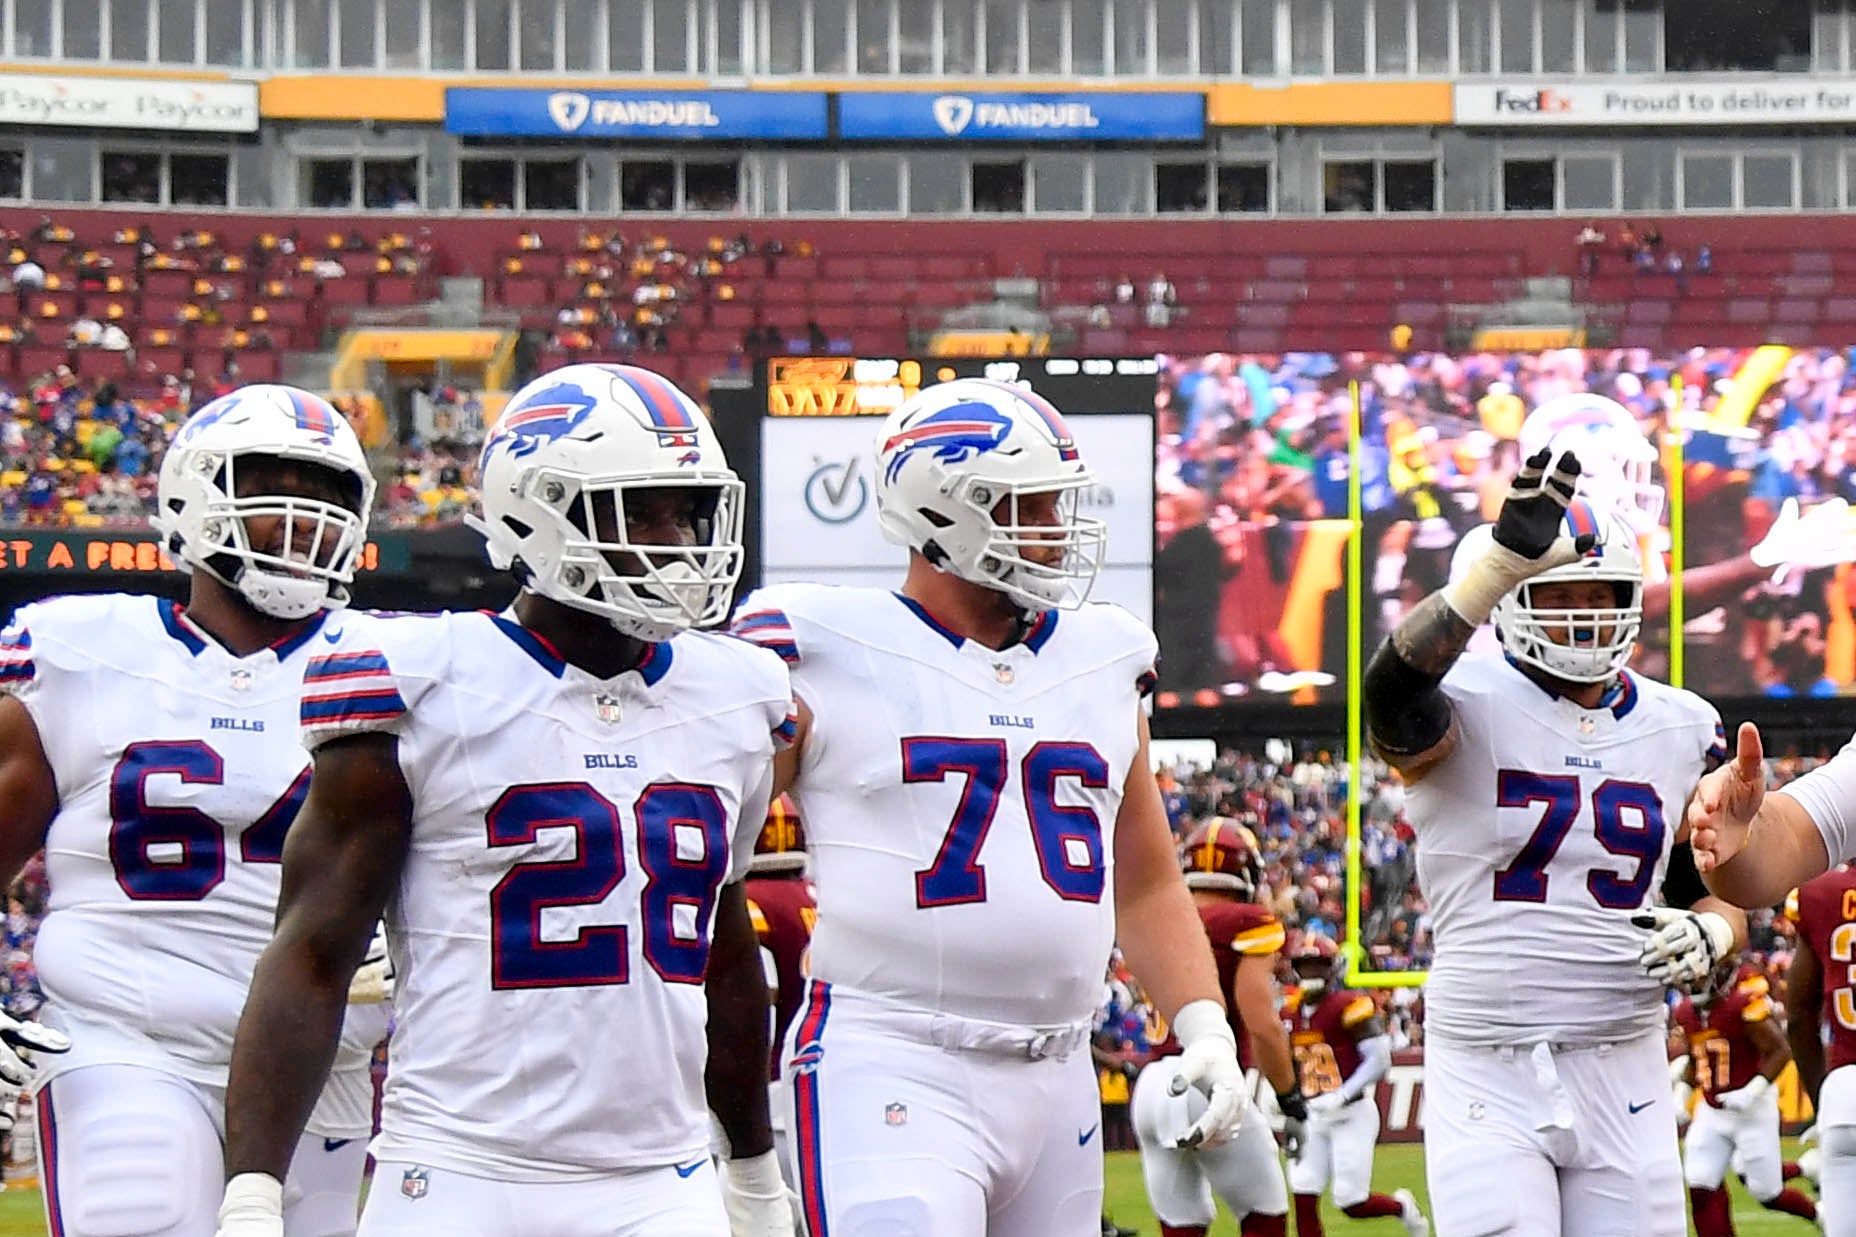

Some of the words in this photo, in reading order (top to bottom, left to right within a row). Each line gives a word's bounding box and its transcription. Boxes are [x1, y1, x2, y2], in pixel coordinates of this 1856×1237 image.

[136, 94, 244, 127] Paycor
[591, 98, 721, 128] FANDUEL
[1495, 89, 1573, 112] FedEx
[1604, 92, 1682, 113] Proud
[1689, 92, 1715, 111] to
[1722, 89, 1808, 111] deliver
[1815, 88, 1850, 110] for
[976, 102, 1098, 128] FANDUEL
[48, 542, 74, 568] A
[211, 717, 264, 732] BILLS
[989, 715, 1034, 729] BILLS
[584, 755, 638, 769] BILLS
[1565, 756, 1602, 769] BILLS
[900, 736, 1109, 909] 76
[1493, 769, 1666, 909] 79
[485, 781, 730, 991] 28
